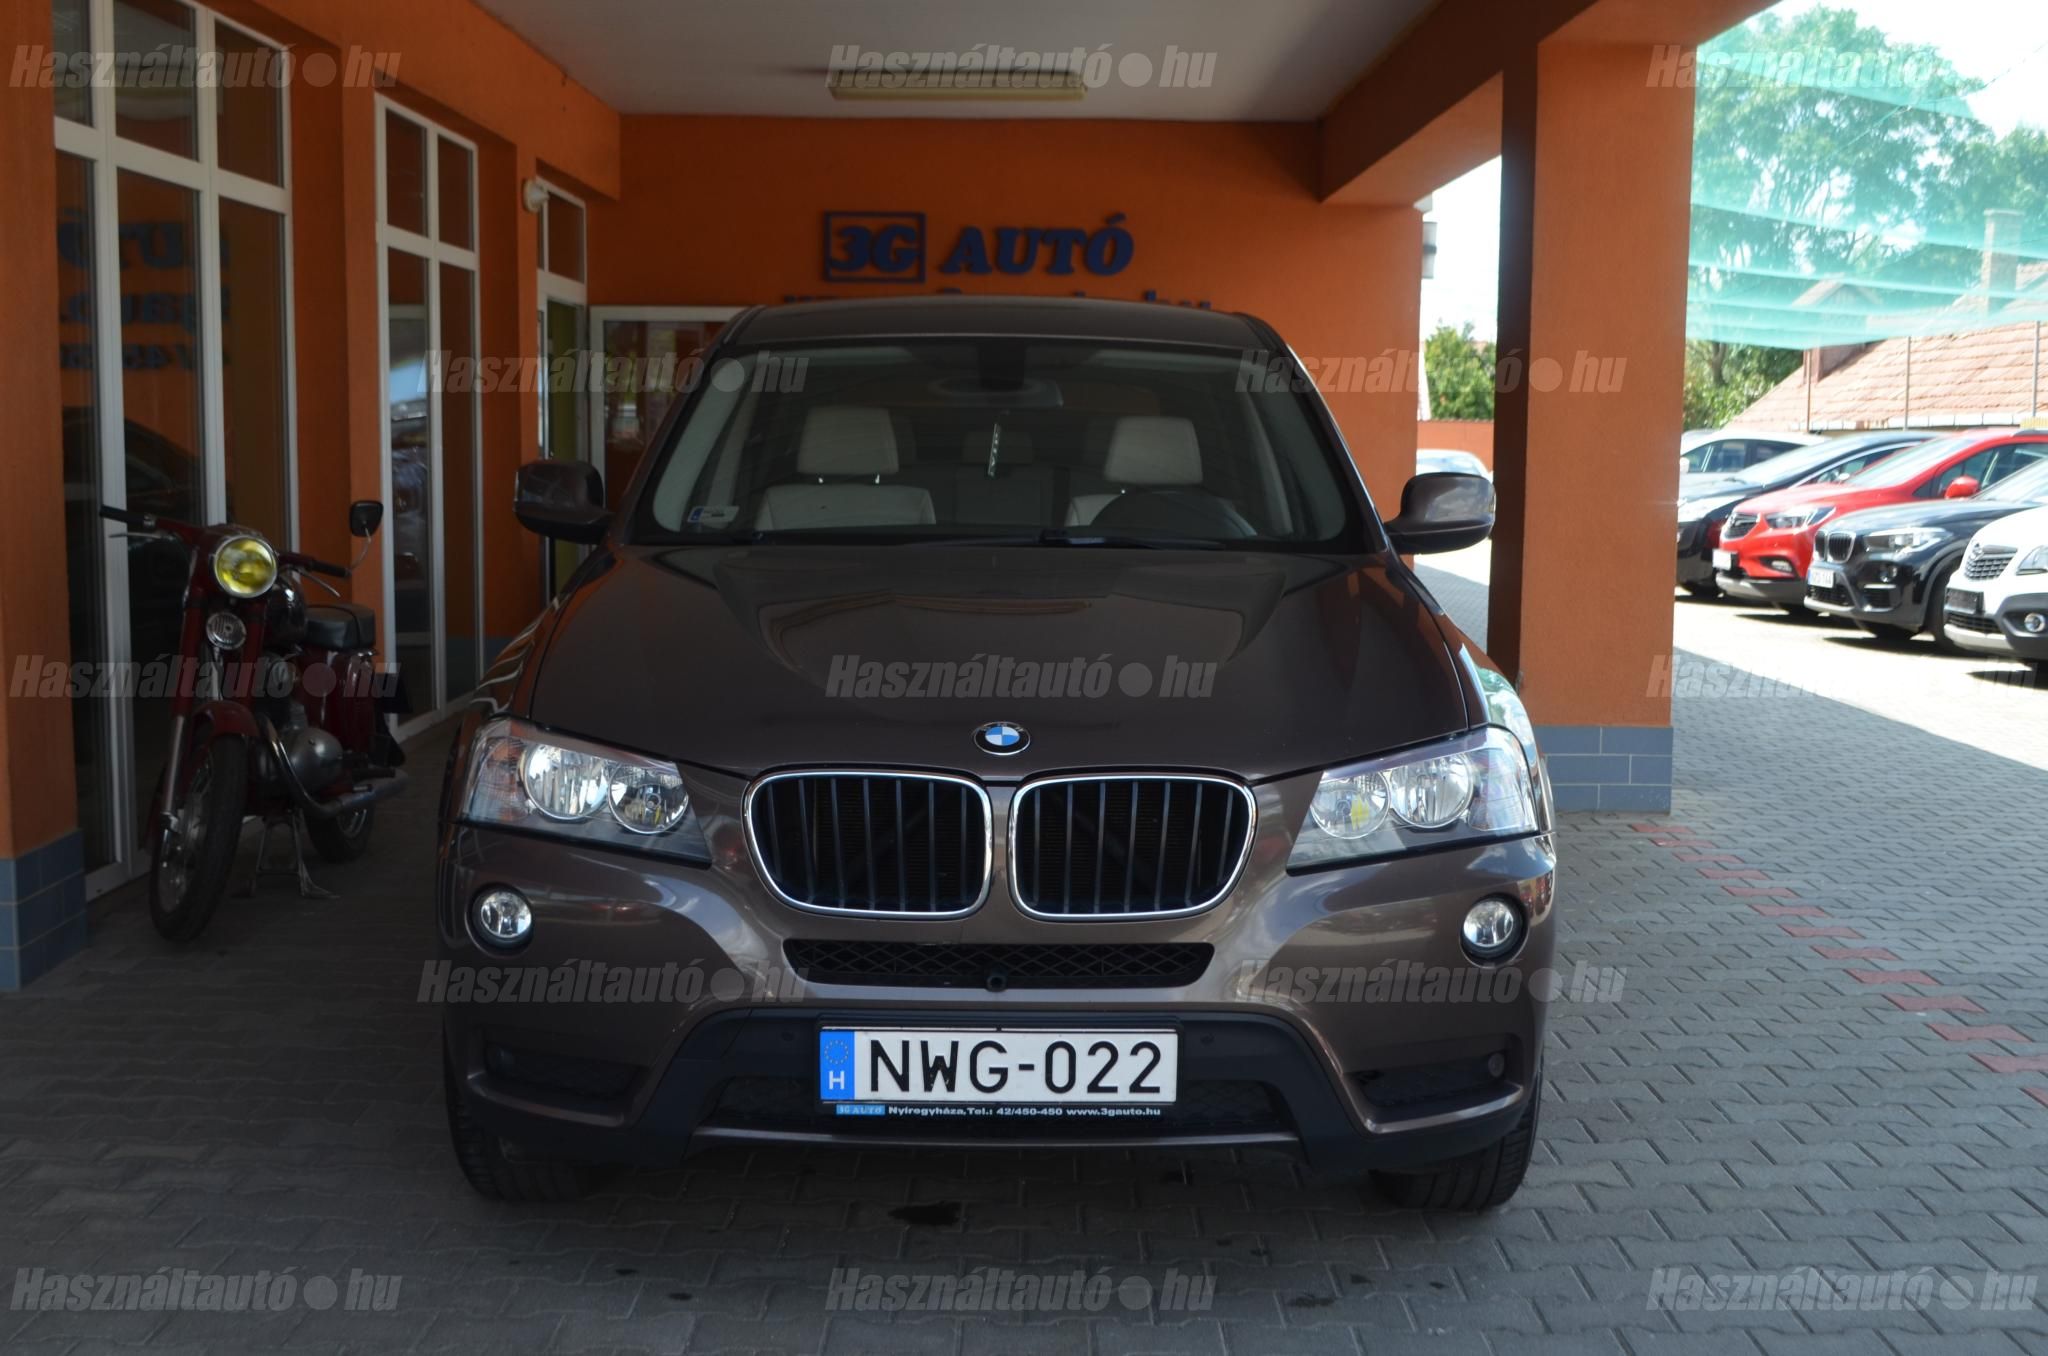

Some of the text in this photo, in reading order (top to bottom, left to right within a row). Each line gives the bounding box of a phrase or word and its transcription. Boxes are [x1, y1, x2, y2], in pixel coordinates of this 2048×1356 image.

[830, 212, 1135, 276] 3G AUTÓ
[828, 1070, 845, 1090] H
[869, 1039, 1162, 1094] NWG-022
[1066, 1107, 1161, 1116] www.3gauto.hu
